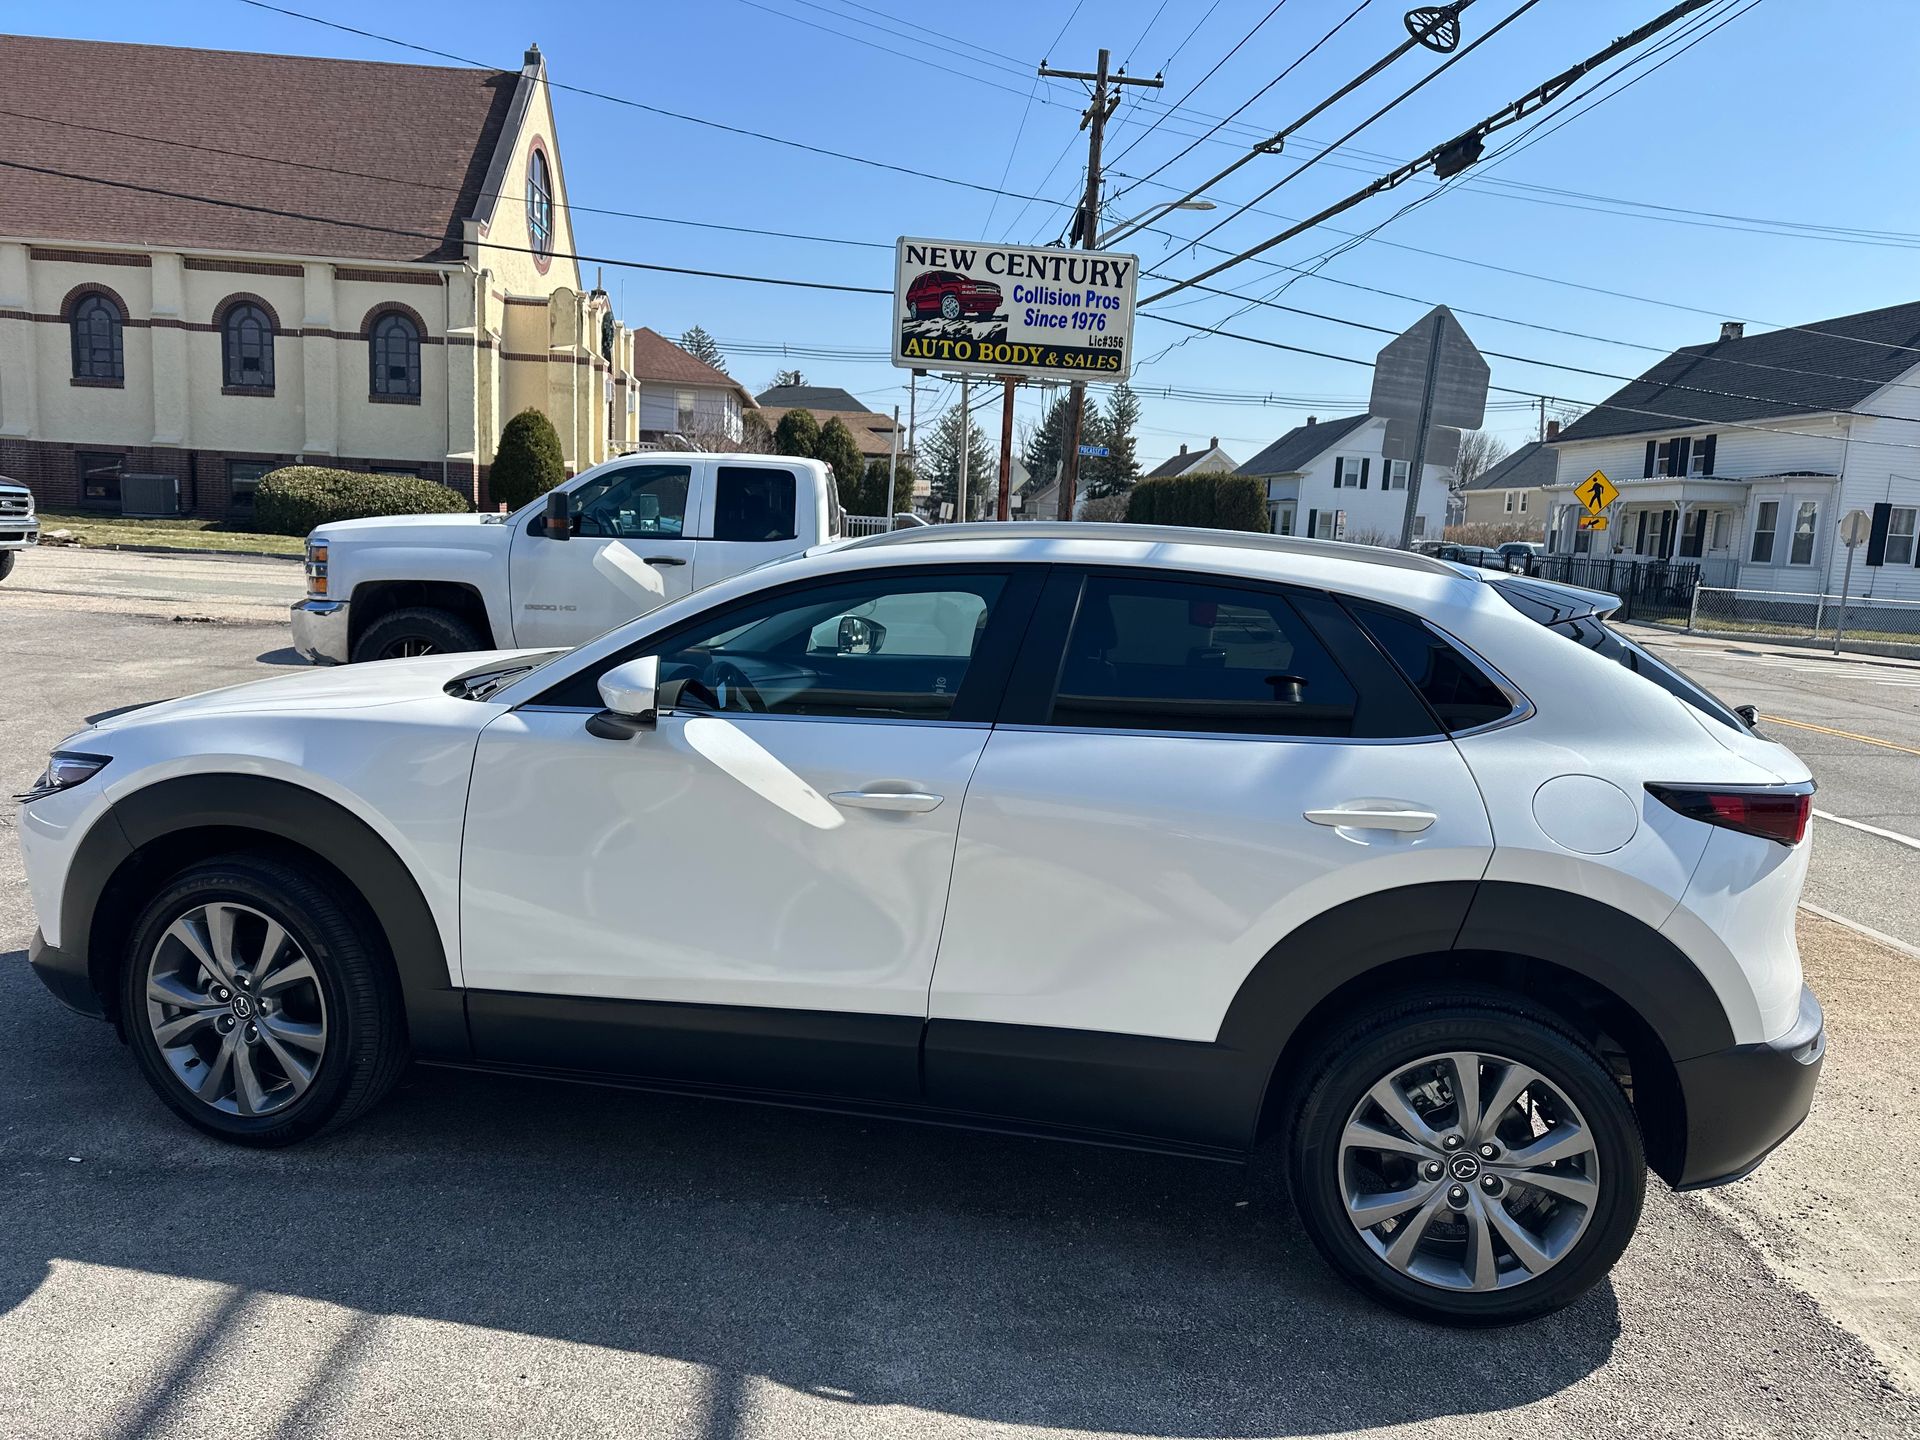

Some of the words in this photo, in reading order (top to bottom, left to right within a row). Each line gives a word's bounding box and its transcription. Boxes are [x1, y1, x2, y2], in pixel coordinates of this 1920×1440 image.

[905, 245, 977, 271] NEW
[985, 251, 1130, 288] CENTURY
[1013, 284, 1080, 307] Collision
[1085, 290, 1120, 310] Pros
[1024, 308, 1068, 329] Since
[1071, 311, 1107, 331] 1976
[904, 337, 972, 359] AUTO
[978, 343, 1044, 365] BODY
[1045, 351, 1058, 367] &
[1062, 352, 1119, 370] SALES
[1088, 334, 1124, 349] Lic#356
